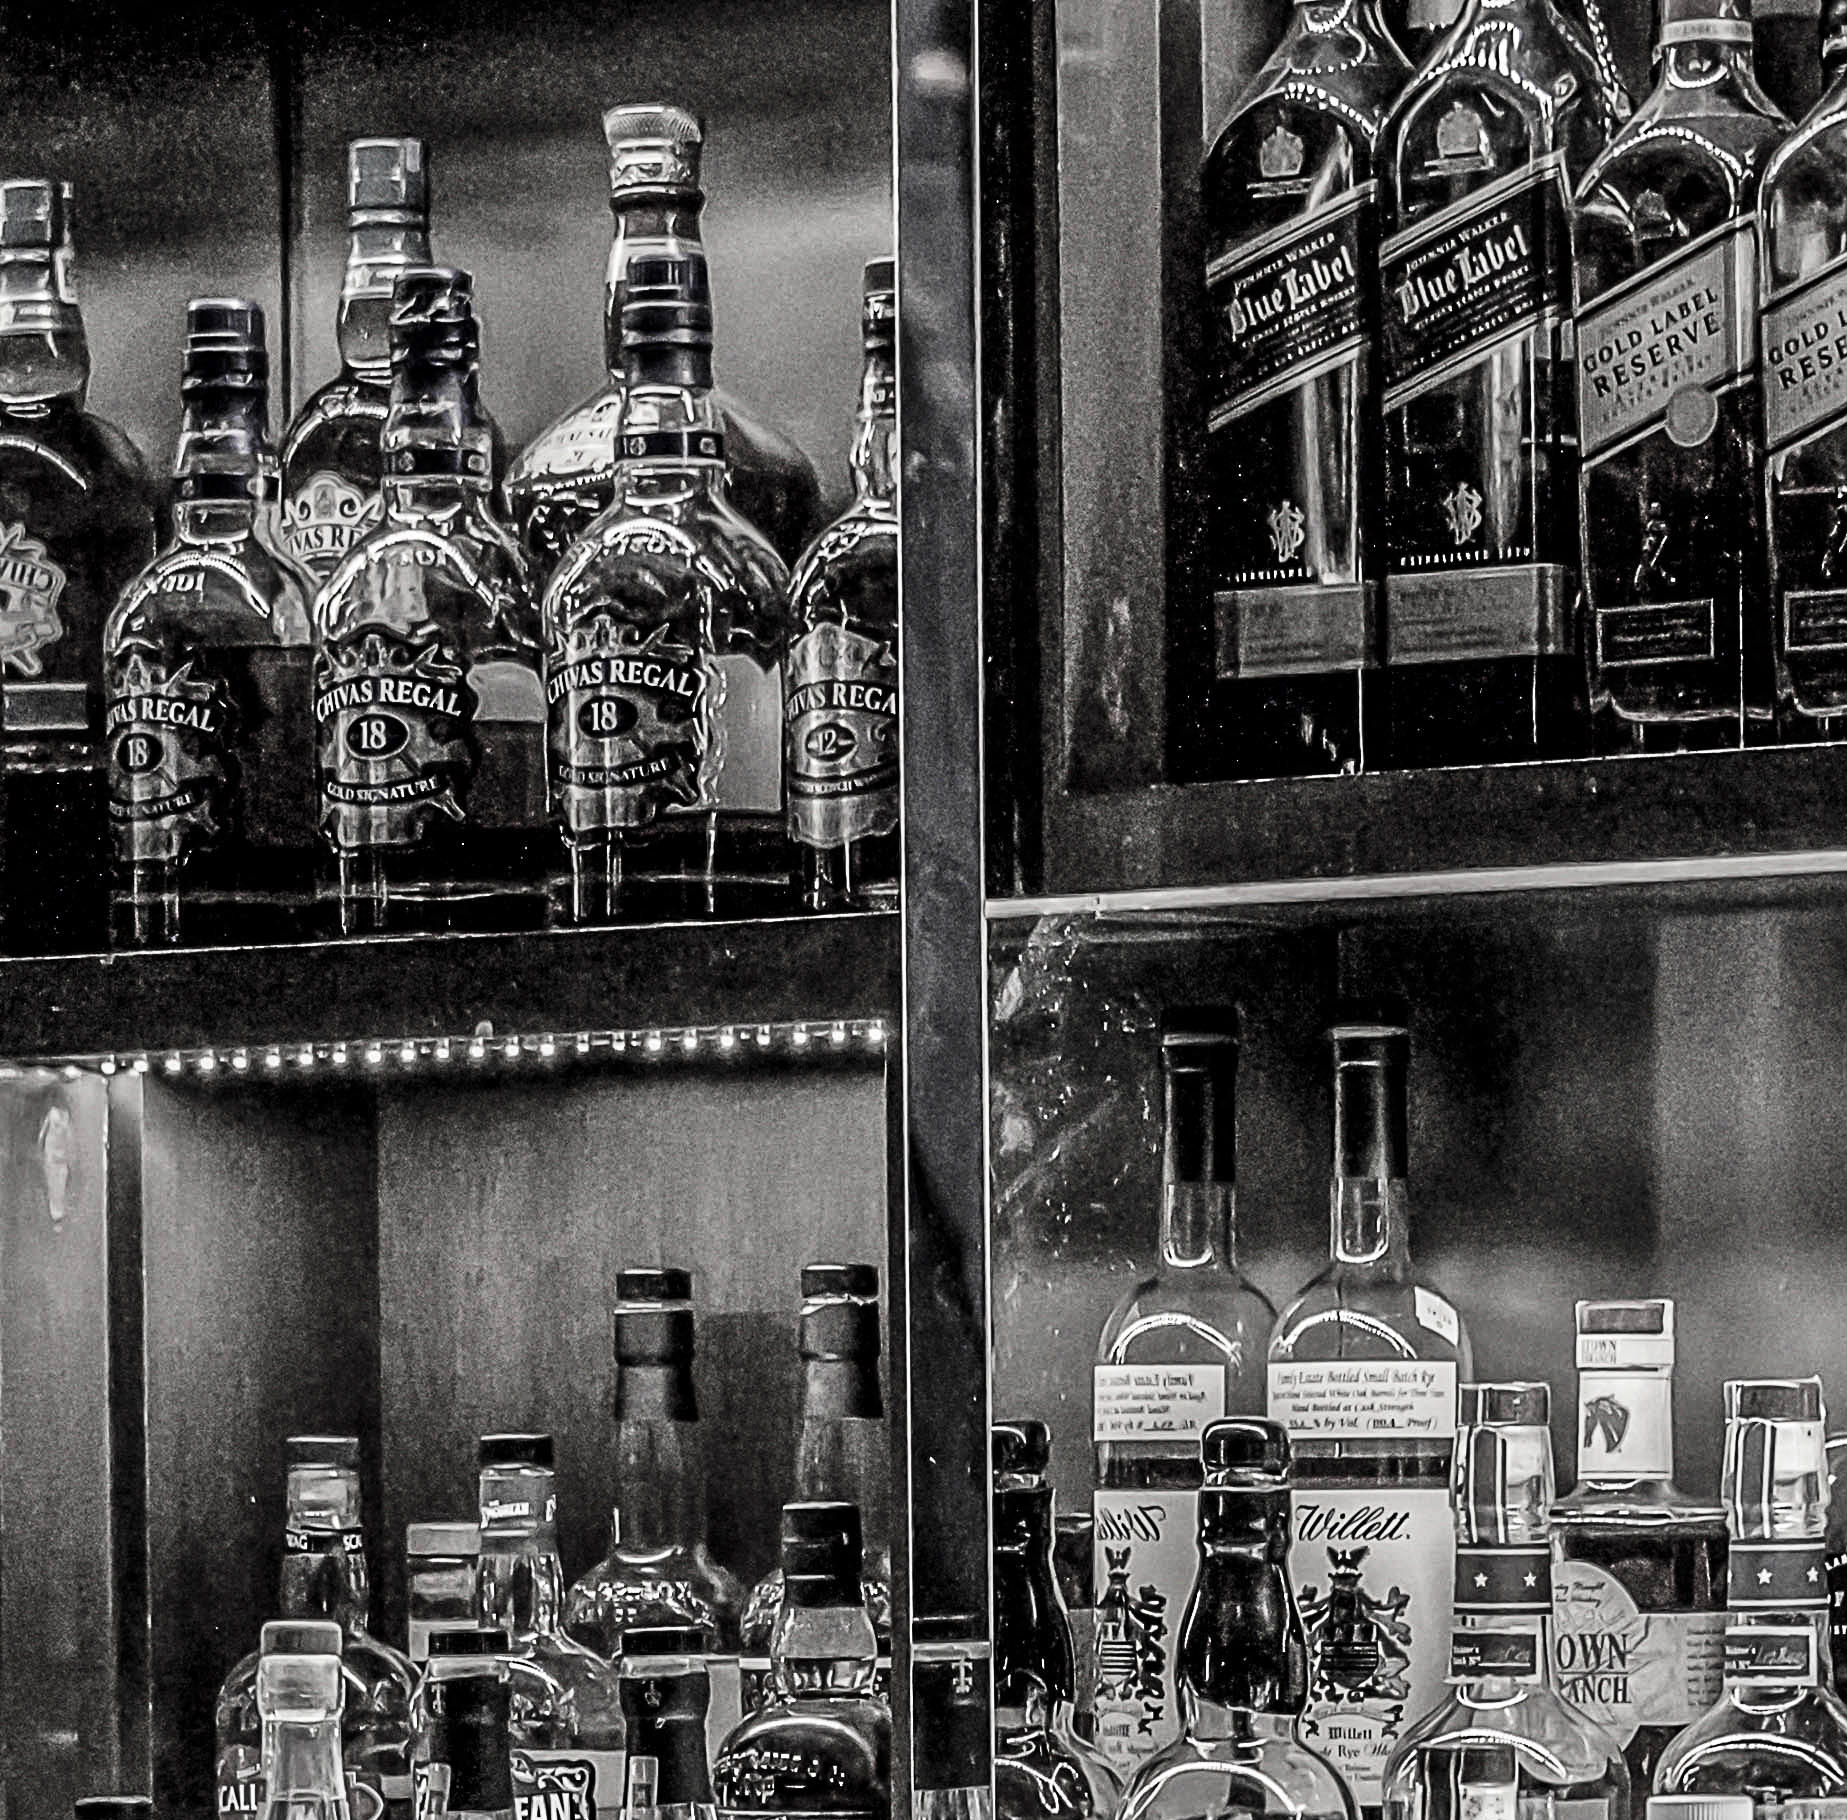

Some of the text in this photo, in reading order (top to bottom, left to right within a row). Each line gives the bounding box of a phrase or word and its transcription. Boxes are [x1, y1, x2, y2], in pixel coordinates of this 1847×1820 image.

[1458, 211, 1509, 243] WALKER
[1285, 232, 1336, 263] WALKER
[1396, 269, 1460, 325] Blue
[1453, 223, 1530, 291] Label
[1228, 287, 1286, 342] Blue
[1281, 244, 1356, 311] Label
[1582, 286, 1719, 373] GOLD LABEL
[1767, 320, 1830, 367] GOLD
[1592, 311, 1721, 398] RESERVE
[610, 658, 694, 699] REGAL
[316, 677, 462, 723] CHIVAS REGAL
[833, 682, 896, 715] REGA
[143, 698, 215, 733] REGAL
[591, 702, 617, 731] 18
[359, 719, 387, 750] 18
[815, 729, 838, 754] 12
[128, 737, 149, 767] 18
[356, 774, 438, 800] SIGNATURE
[1328, 1368, 1359, 1384] Bottled
[1327, 1726, 1373, 1742] Willett
[1337, 1745, 1360, 1760] Rye
